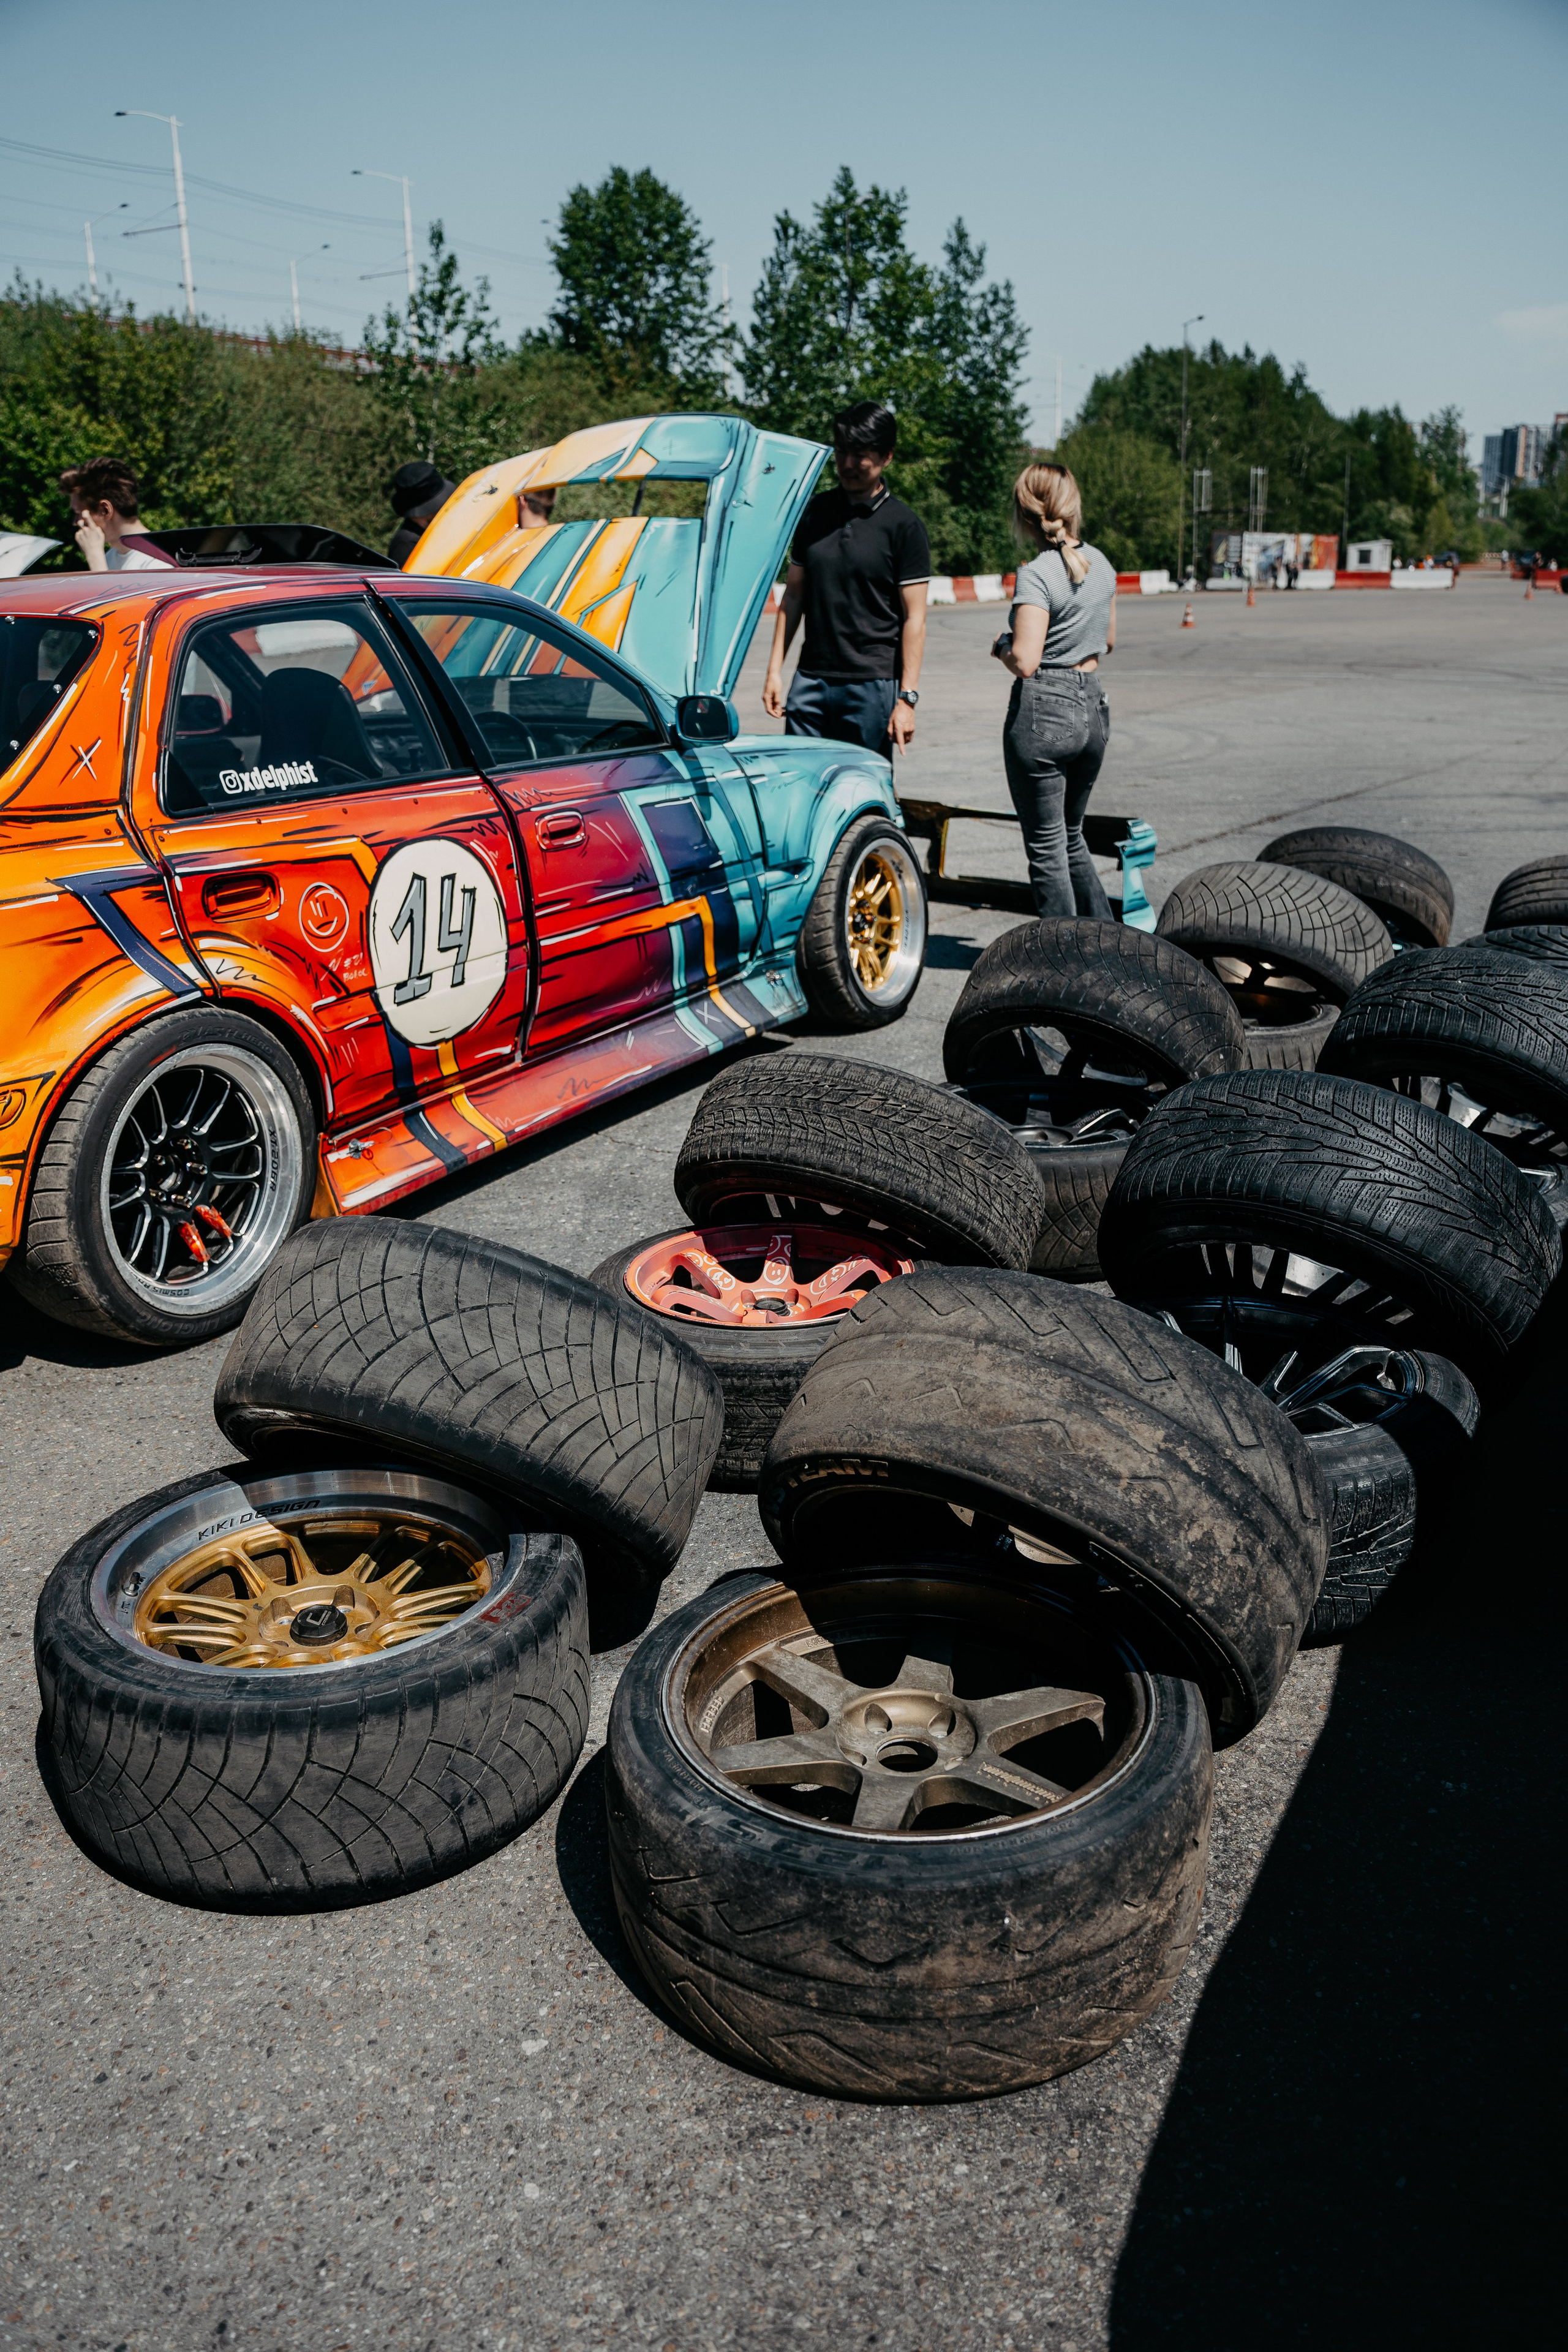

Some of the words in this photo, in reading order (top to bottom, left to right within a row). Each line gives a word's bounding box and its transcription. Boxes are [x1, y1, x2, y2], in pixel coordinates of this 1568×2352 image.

[243, 760, 318, 793] xdelphist
[390, 872, 477, 1006] 14
[151, 1286, 191, 1297] COSMIS
[136, 1310, 221, 1336] LINGLONG
[777, 1458, 889, 1489] TEAM
[196, 1517, 235, 1541] KIKI
[238, 1499, 322, 1525] DESIGN
[699, 1695, 725, 1733] FORGED
